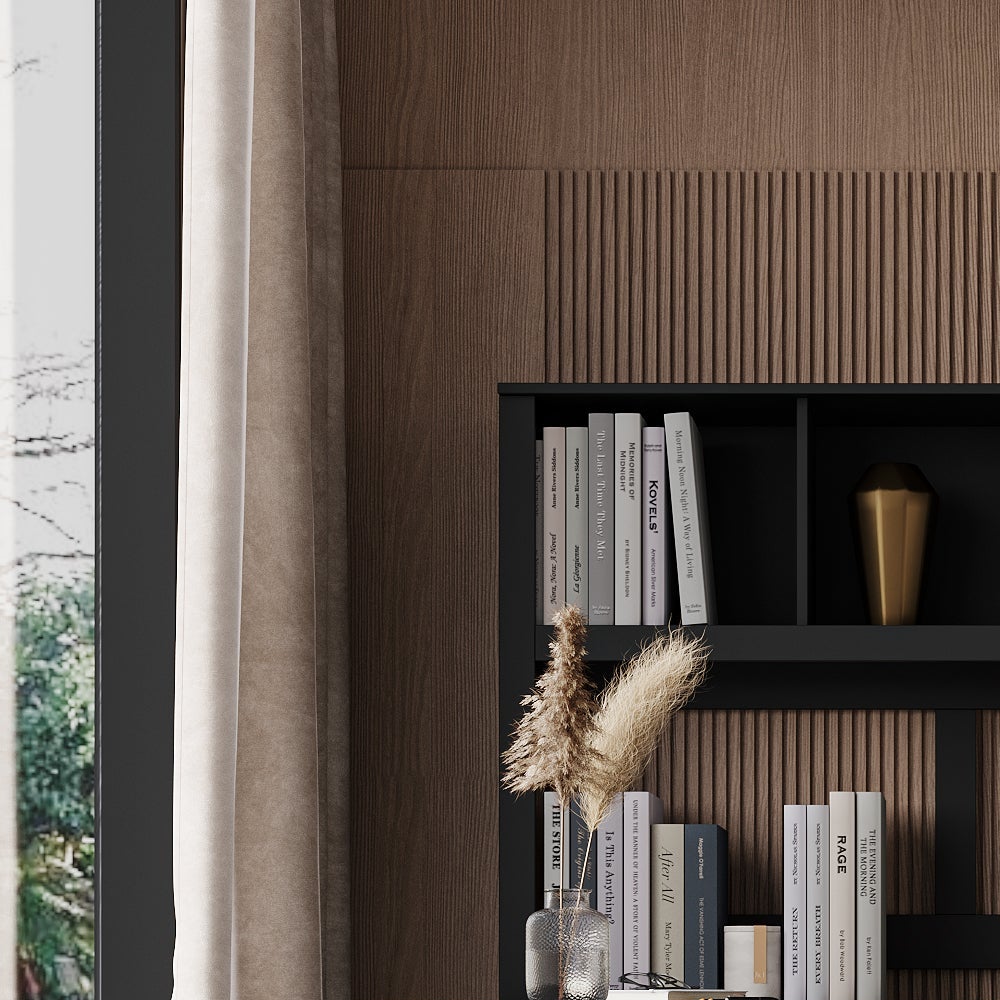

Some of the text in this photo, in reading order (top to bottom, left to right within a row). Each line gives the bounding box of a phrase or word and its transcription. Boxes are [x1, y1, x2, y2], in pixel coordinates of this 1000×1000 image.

[674, 430, 684, 464] Morning
[679, 466, 687, 486] Noon
[595, 430, 605, 560] The Last Time They Met
[628, 489, 635, 500] OF
[679, 489, 689, 514] Night:
[649, 480, 659, 534] KOVELS'
[682, 524, 691, 540] Way
[549, 532, 557, 555] Novel
[685, 543, 693, 551] of
[686, 553, 695, 578] Living
[573, 584, 580, 594] La
[552, 804, 561, 870] THE STORE
[577, 828, 585, 844] The
[837, 835, 847, 874] RAGE
[633, 861, 638, 869] OF
[604, 831, 615, 925] Is This Anything?
[658, 847, 674, 904] After All
[633, 925, 638, 933] OF
[664, 922, 672, 940] Mary
[664, 942, 672, 961] Tyler
[699, 947, 704, 955] OF
